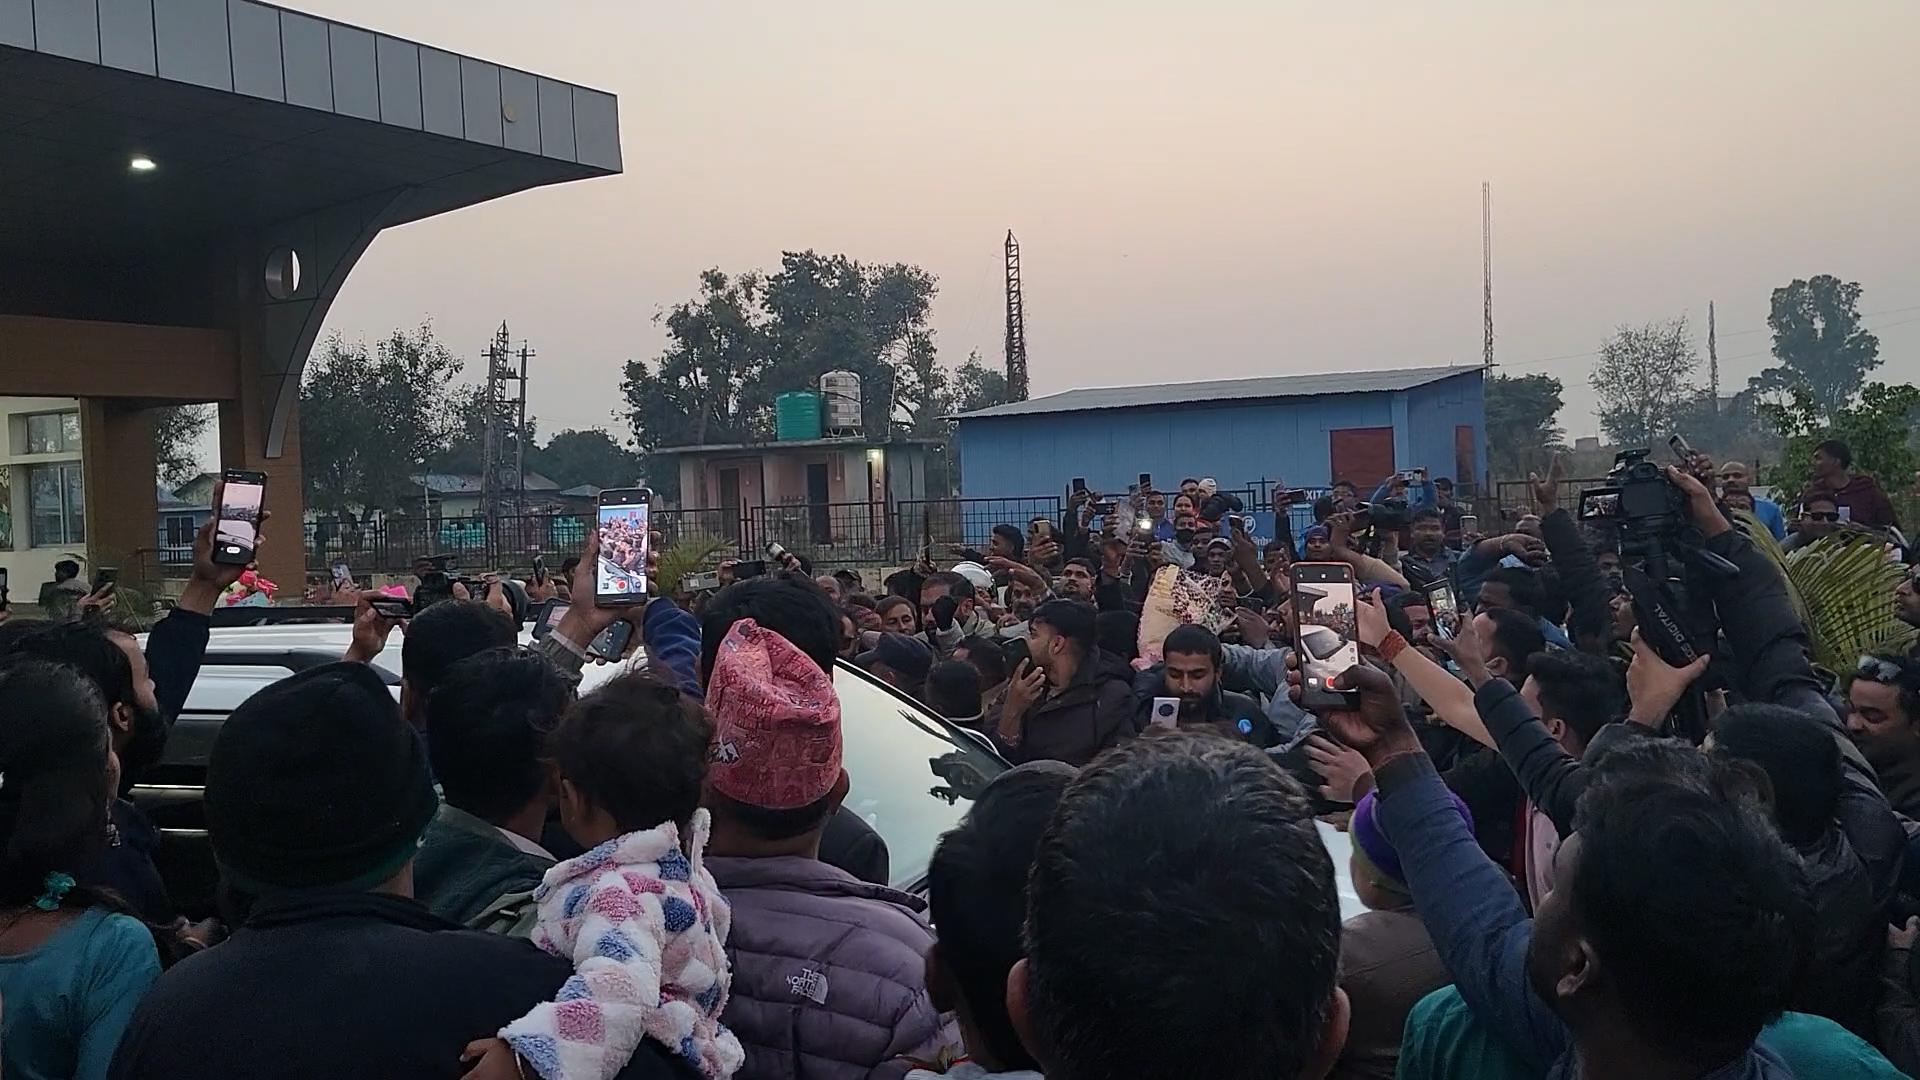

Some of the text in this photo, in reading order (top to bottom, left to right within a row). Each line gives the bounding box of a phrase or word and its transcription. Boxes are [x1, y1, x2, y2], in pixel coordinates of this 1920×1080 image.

[1654, 603, 1685, 643] DIGITAL
[802, 968, 819, 982] THE
[786, 975, 816, 992] NORTH
[791, 985, 815, 998] FACE
